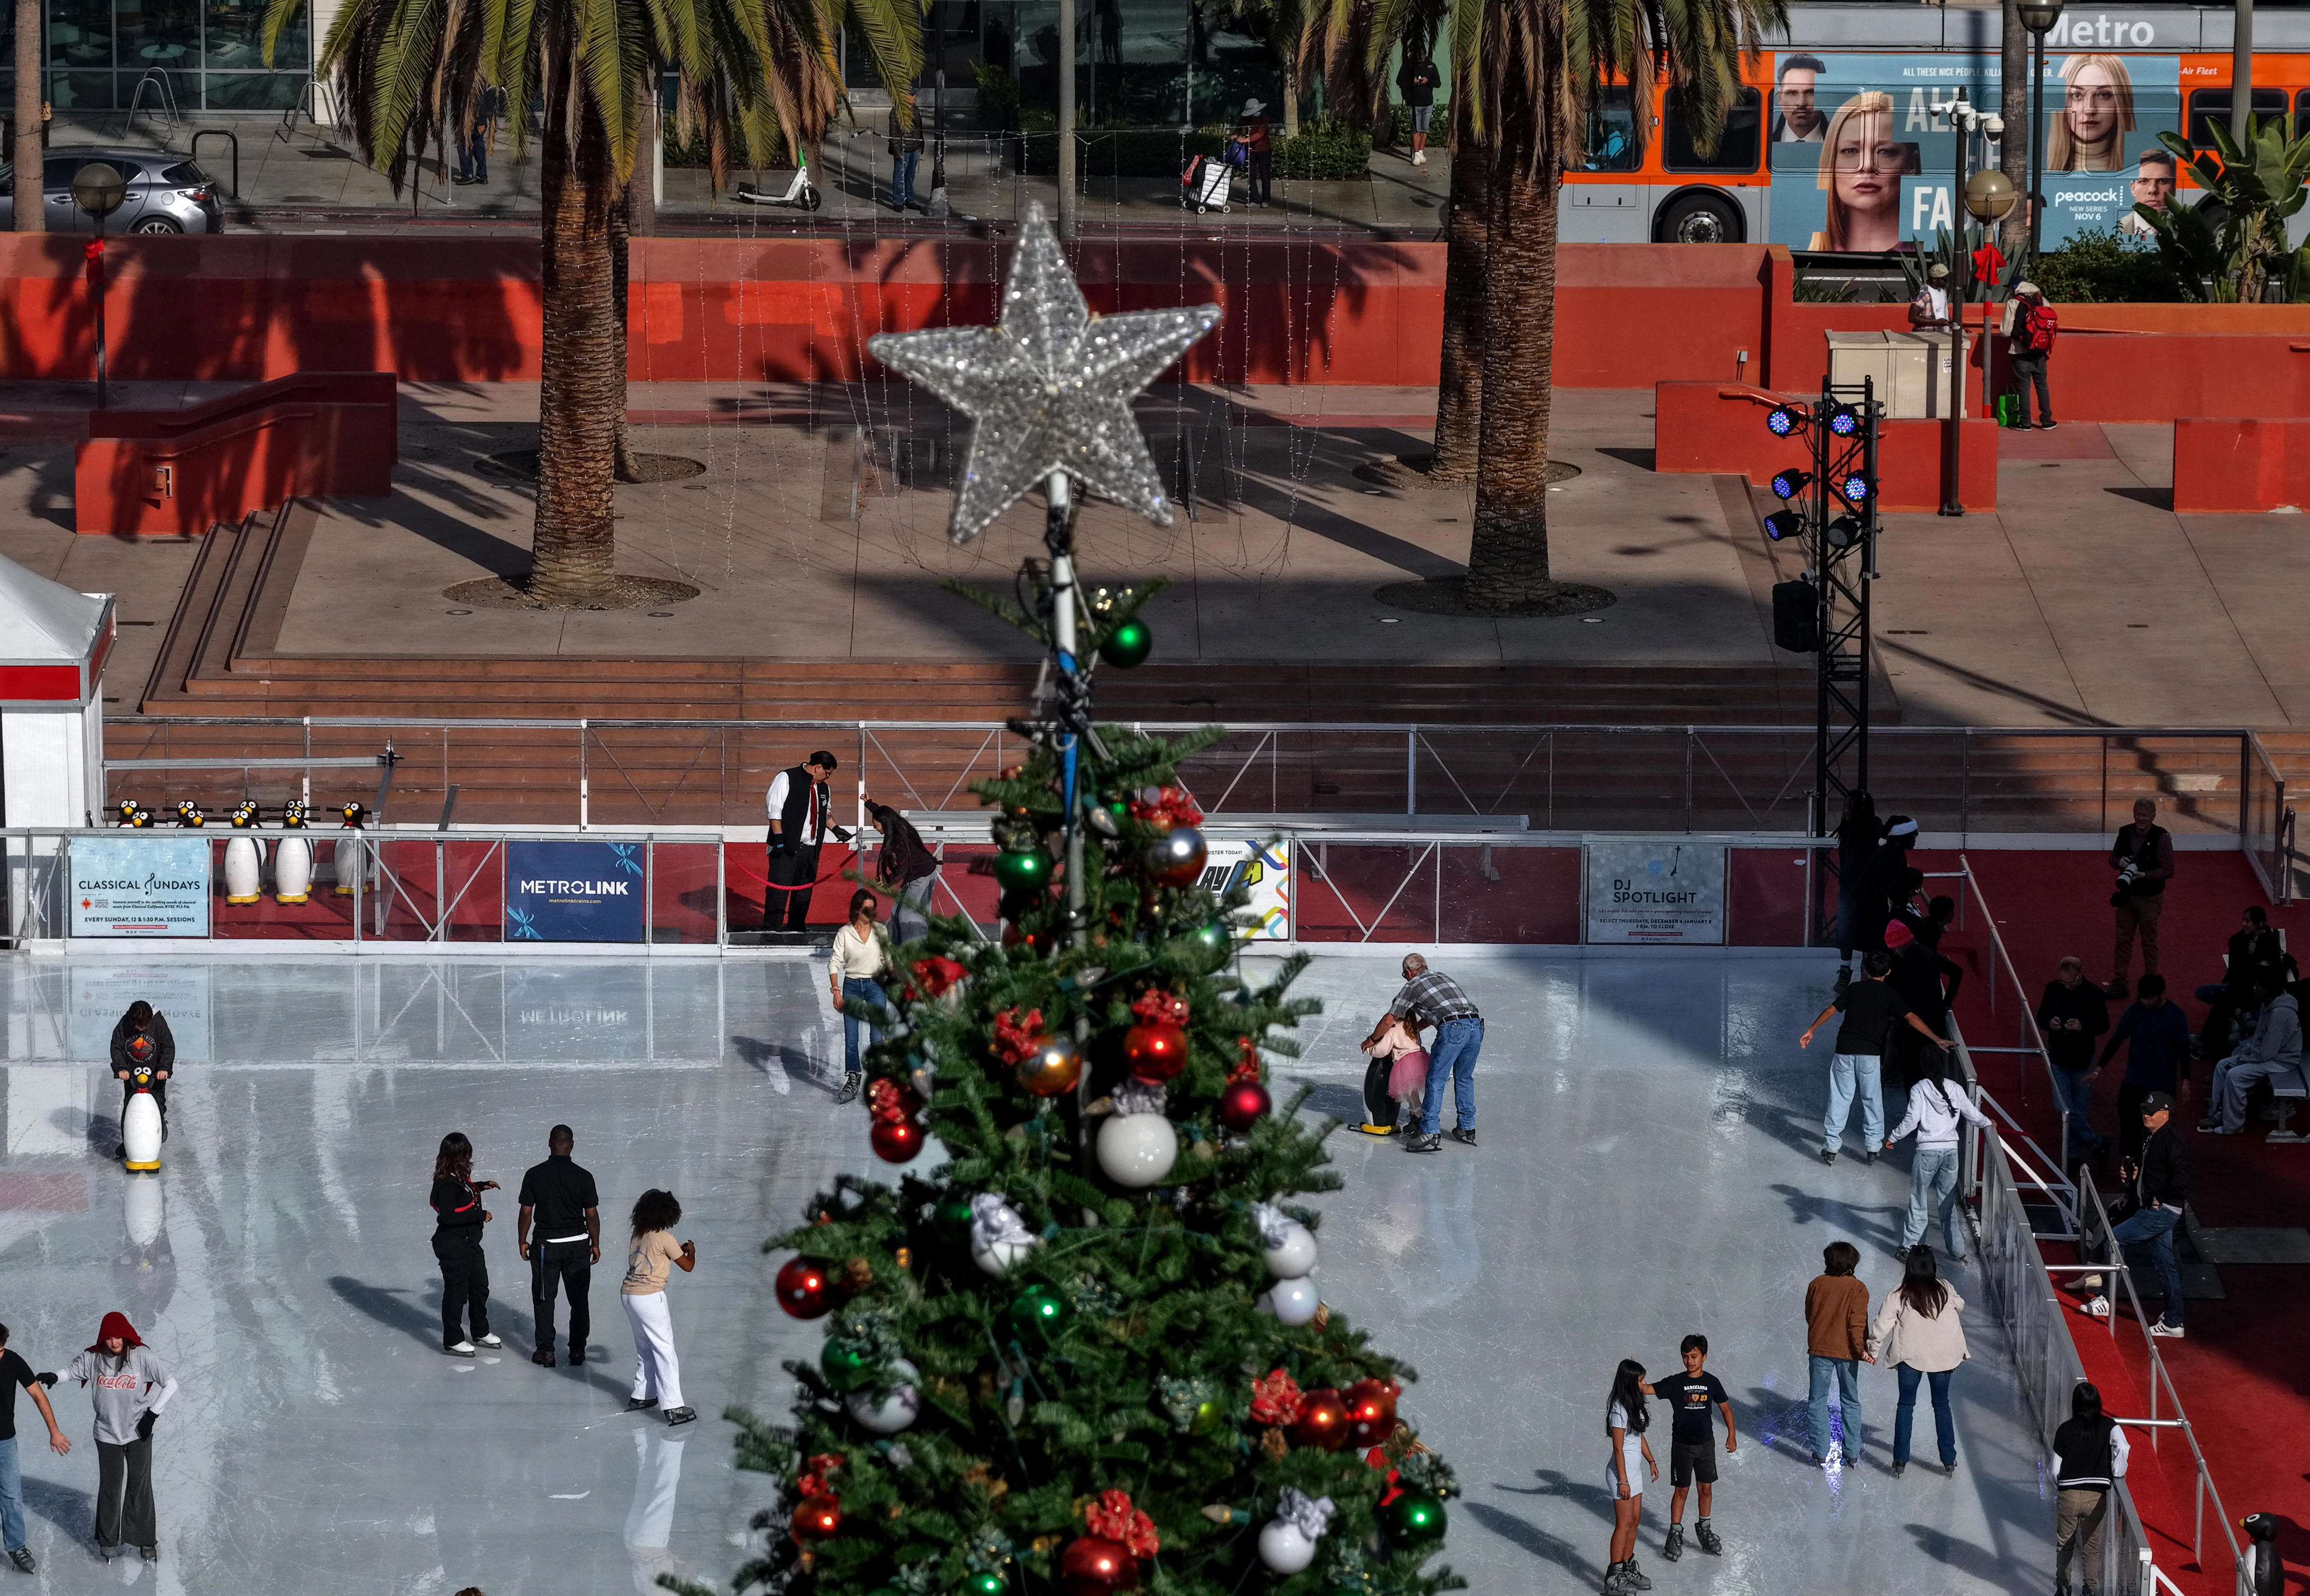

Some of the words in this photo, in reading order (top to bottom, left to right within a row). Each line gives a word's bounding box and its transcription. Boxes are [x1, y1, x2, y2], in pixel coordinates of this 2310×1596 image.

[1903, 68, 1915, 77] ALL
[1917, 68, 1937, 77] THESE
[1939, 68, 1954, 77] NICE
[1955, 68, 1983, 77] PEOPLE.
[1985, 68, 2002, 77] KILLI
[2030, 68, 2053, 77] OER.
[2196, 67, 2218, 75] Fleet
[2055, 188, 2118, 207] peacock
[79, 880, 140, 889] CLASSICAL
[521, 880, 629, 895] METROLINK
[1614, 879, 1631, 891] DJ
[1613, 892, 1697, 903] SPOTLIGHT
